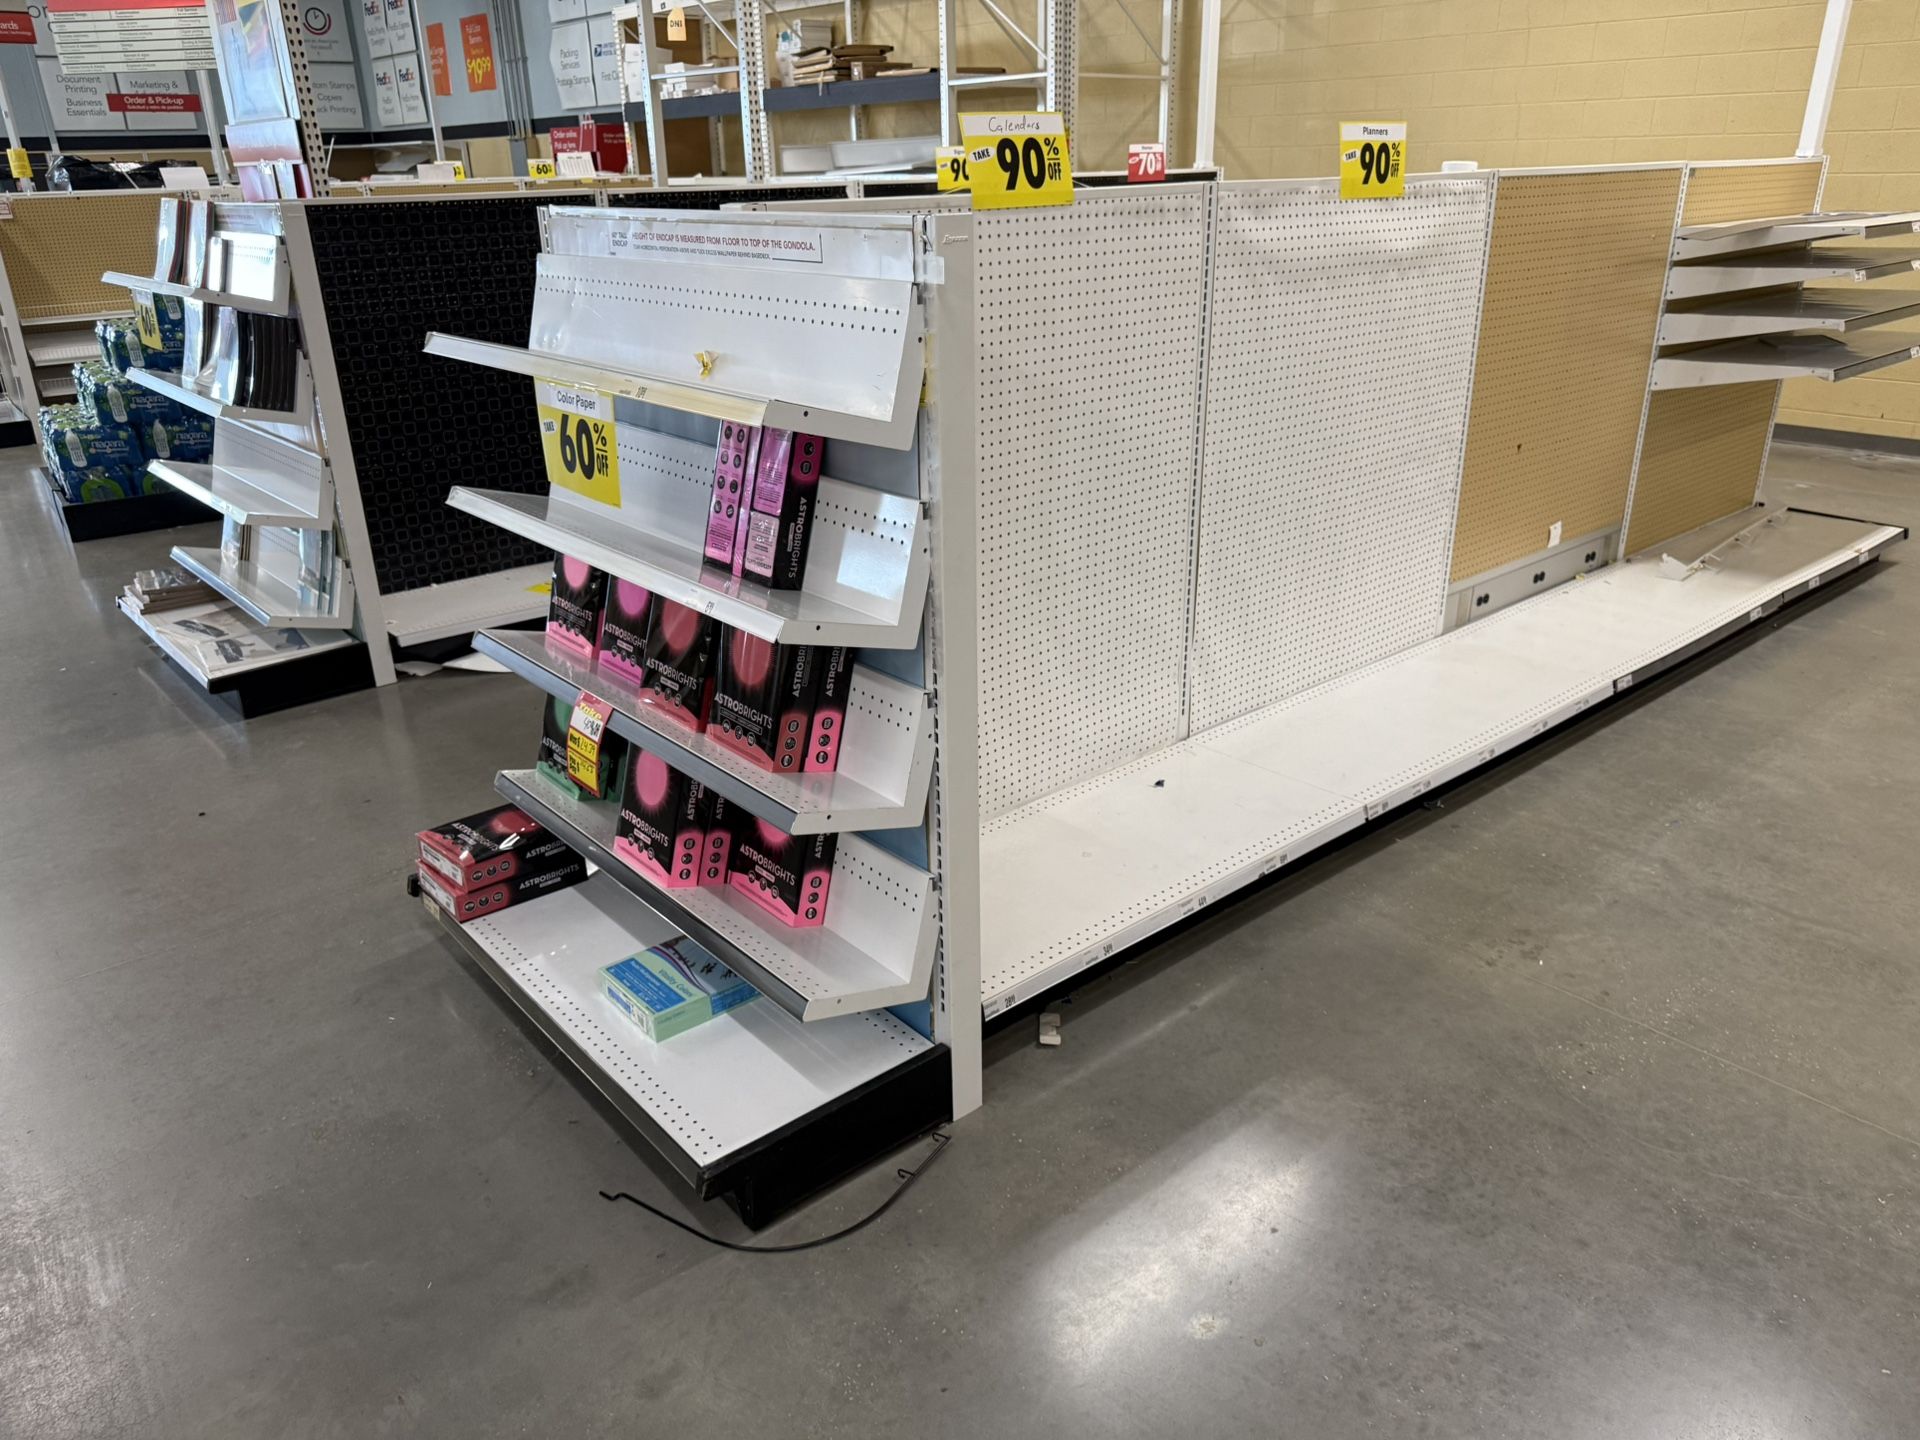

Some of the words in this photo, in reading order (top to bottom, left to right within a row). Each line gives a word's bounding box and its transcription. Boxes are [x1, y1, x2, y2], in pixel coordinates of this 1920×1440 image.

[56, 74, 102, 84] Document
[130, 81, 171, 92] Marketing
[65, 84, 98, 96] Printing
[66, 98, 103, 107] Business
[124, 96, 147, 105] Order
[156, 97, 185, 106] Pick-up
[67, 107, 108, 117] Essentials
[1362, 126, 1389, 136] Planners
[973, 148, 990, 161] TAKE
[1047, 161, 1062, 181] OFF
[1390, 162, 1400, 178] OFF
[655, 233, 674, 242] ENDCAP
[680, 234, 706, 244] MEASURED
[706, 235, 721, 245] FROM
[721, 237, 740, 246] FLOOR
[740, 238, 749, 247] TO
[749, 238, 761, 248] TOP
[761, 239, 770, 249] OF
[770, 240, 782, 249] THE
[782, 240, 816, 252] GONDOLA.
[557, 390, 575, 405] Color
[575, 394, 597, 411] Paper
[596, 453, 608, 478] OFF
[788, 496, 807, 579] ASTROBRIGHTS
[646, 657, 698, 690] ASTROBRIGHTS
[714, 691, 773, 729] ASTROBRIGHTS
[621, 807, 669, 847] ASTROBRIGHTS
[740, 843, 796, 887] ASTROBRIGHTS
[519, 863, 580, 890] ASTROBRIGHTS
